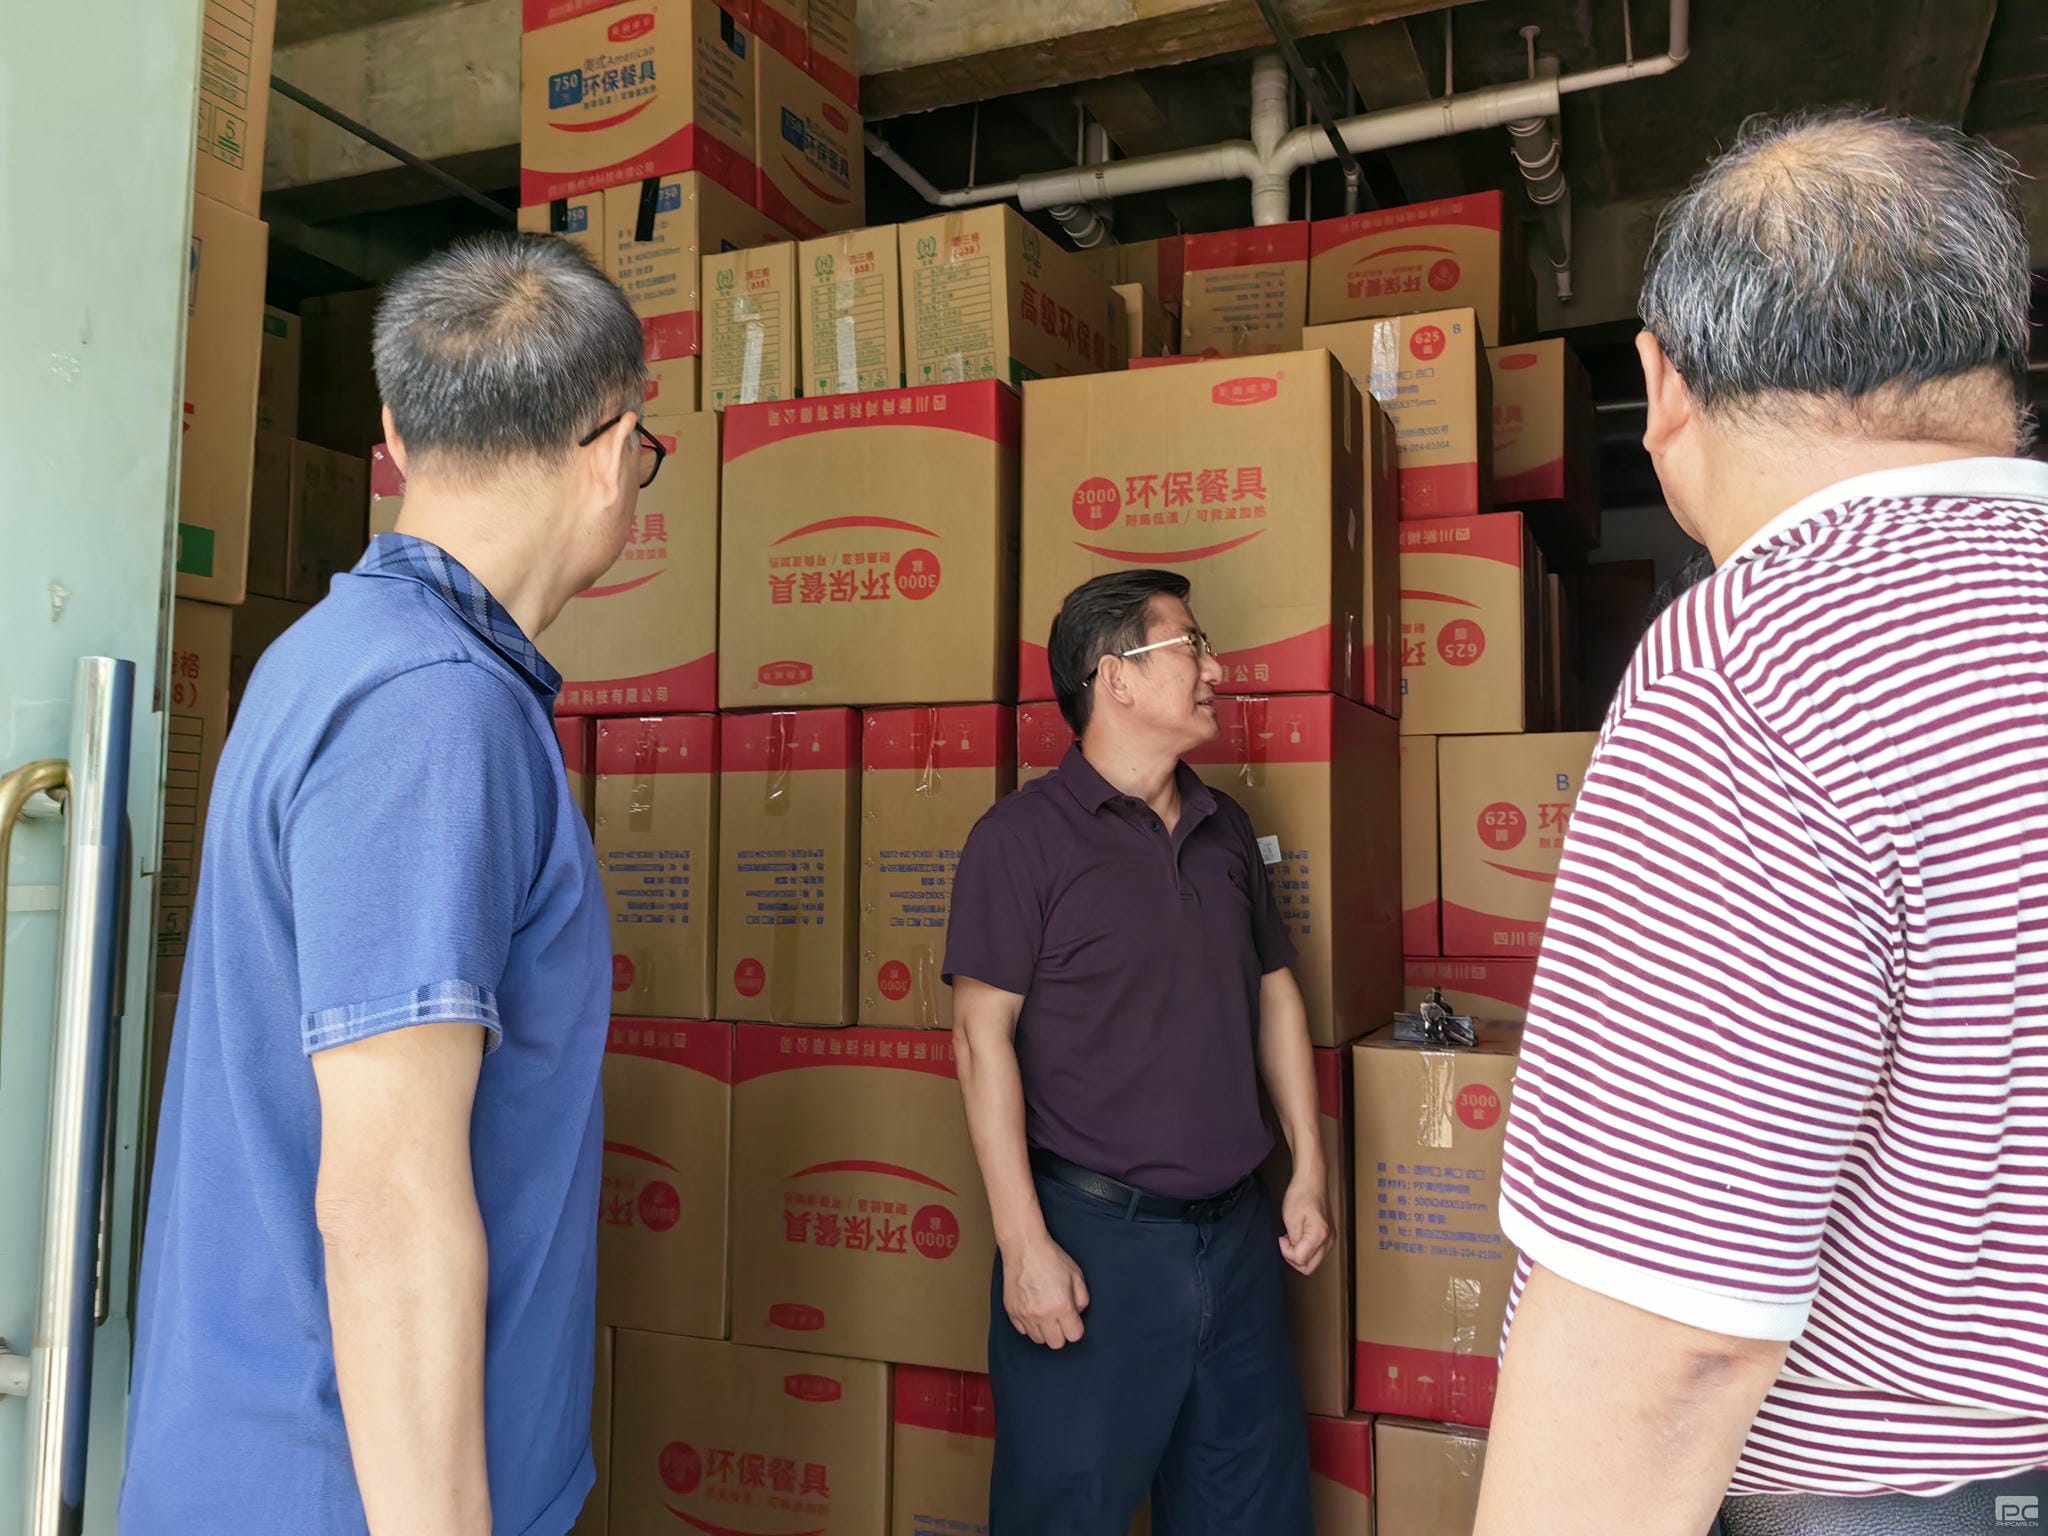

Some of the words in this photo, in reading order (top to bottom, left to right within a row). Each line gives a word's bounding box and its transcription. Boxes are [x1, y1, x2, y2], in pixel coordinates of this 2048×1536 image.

[553, 73, 579, 92] 750
[582, 60, 656, 97] 环保餐具
[1415, 331, 1441, 344] 625
[1076, 488, 1117, 505] 3000
[1125, 466, 1268, 509] 环保餐具
[768, 568, 891, 605] 环保餐具
[899, 574, 937, 589] 3000
[1445, 643, 1477, 658] 625
[1556, 774, 1570, 791] B
[1485, 811, 1519, 826] 625
[1460, 1094, 1497, 1108] 3000
[784, 1211, 908, 1254] 环保餐具
[916, 1230, 955, 1248] 3000
[705, 1448, 831, 1498] 环保餐具
